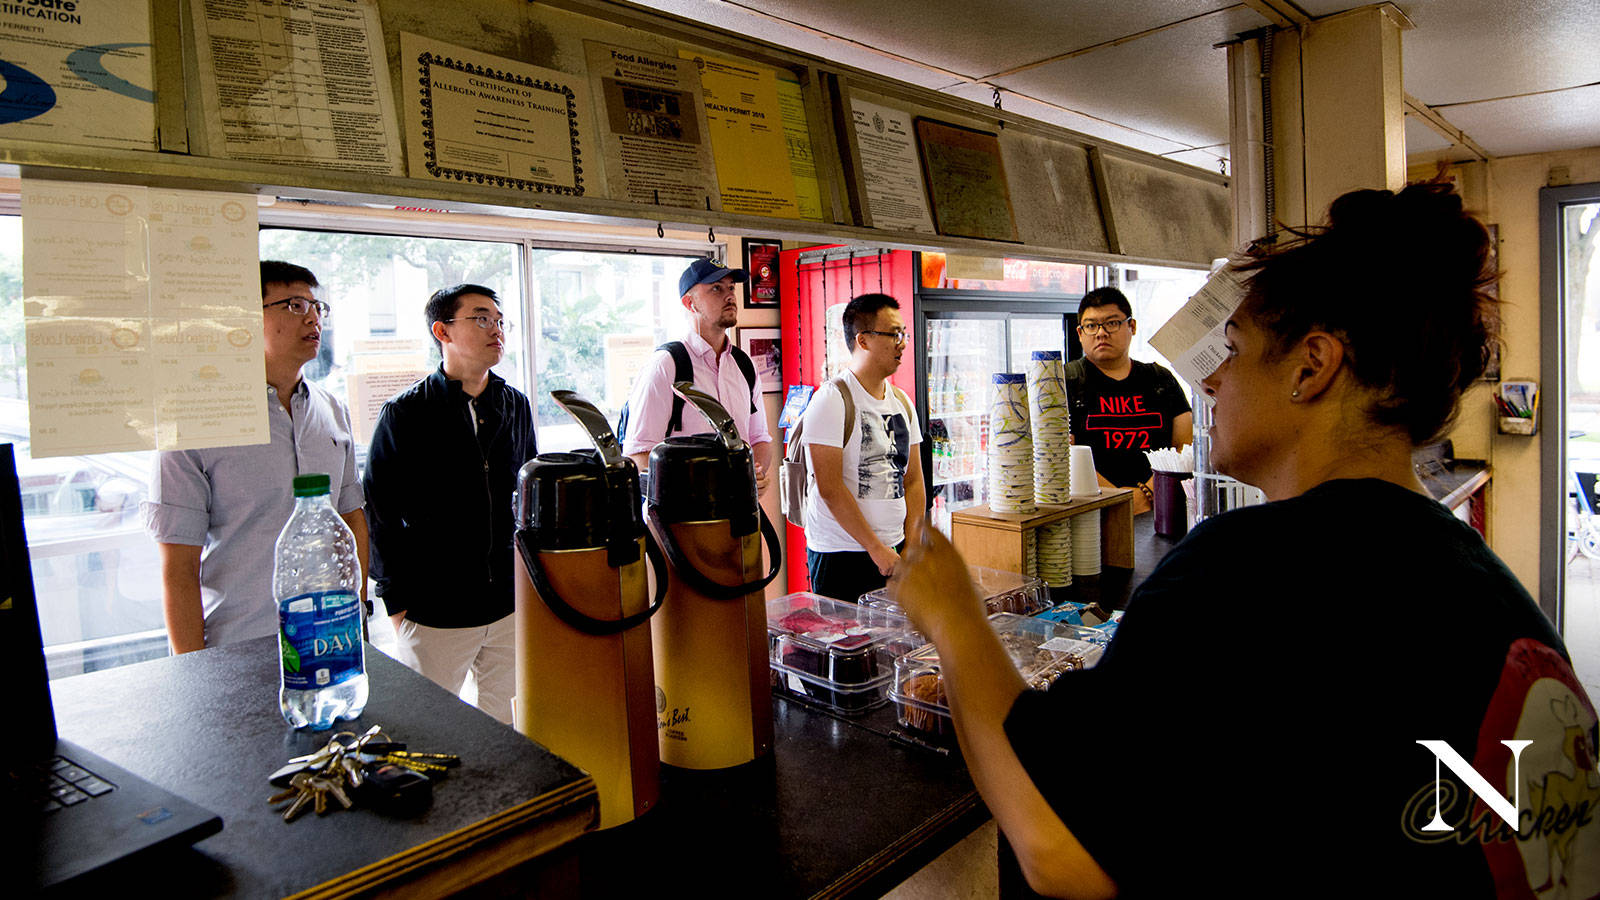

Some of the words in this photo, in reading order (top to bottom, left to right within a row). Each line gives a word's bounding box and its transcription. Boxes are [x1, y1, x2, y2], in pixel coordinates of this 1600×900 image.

[0, 2, 81, 25] TIFICATION
[611, 50, 635, 63] Food
[637, 55, 678, 71] Allergies
[433, 80, 476, 97] ALLERGEN
[478, 90, 525, 108] AWARENESS
[527, 101, 566, 116] TRAINING
[468, 78, 520, 96] CERTIFICATE
[521, 89, 534, 99] OF
[704, 102, 729, 114] HEALTH
[729, 106, 751, 117] PERMIT
[1099, 395, 1147, 414] NIKE
[1103, 430, 1151, 449] 1972
